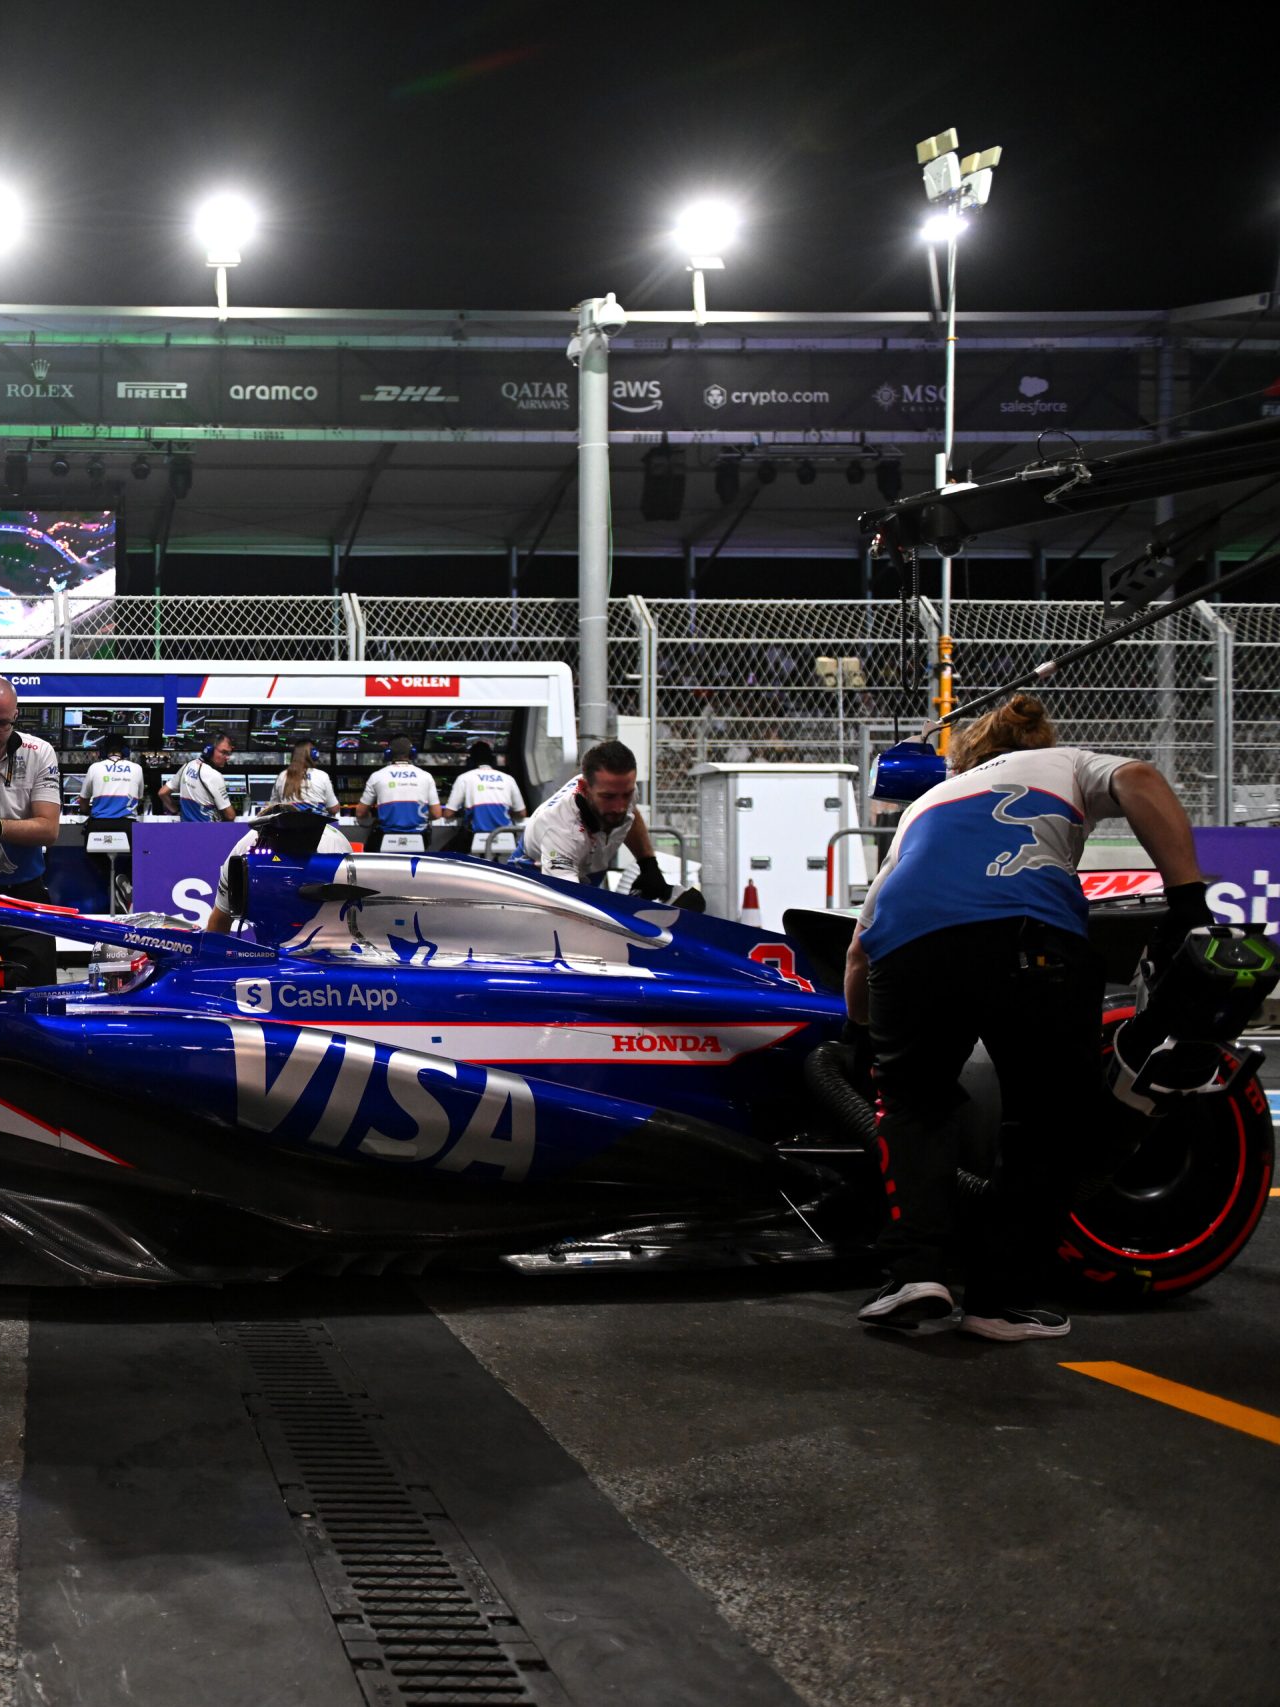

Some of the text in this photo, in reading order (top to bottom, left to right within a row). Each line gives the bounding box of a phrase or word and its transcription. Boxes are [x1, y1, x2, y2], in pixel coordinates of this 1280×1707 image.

[6, 384, 75, 398] ROLEX
[117, 382, 187, 398] PIRELLI
[230, 384, 318, 401] aramco
[372, 386, 447, 402] DHL
[501, 382, 568, 398] QATAR
[613, 380, 661, 399] aws
[731, 386, 830, 405] crypto.com
[517, 398, 570, 409] AIRWAYS
[1000, 399, 1068, 415] salesforce
[401, 676, 450, 688] ORLEN
[105, 764, 131, 773] VISA
[477, 774, 503, 782] VISA
[125, 932, 193, 955] XMTRADING
[106, 951, 128, 959] HUGO
[278, 984, 342, 1008] Cash
[347, 984, 398, 1011] App
[612, 1035, 721, 1053] HONDA
[225, 1018, 536, 1183] VISA
